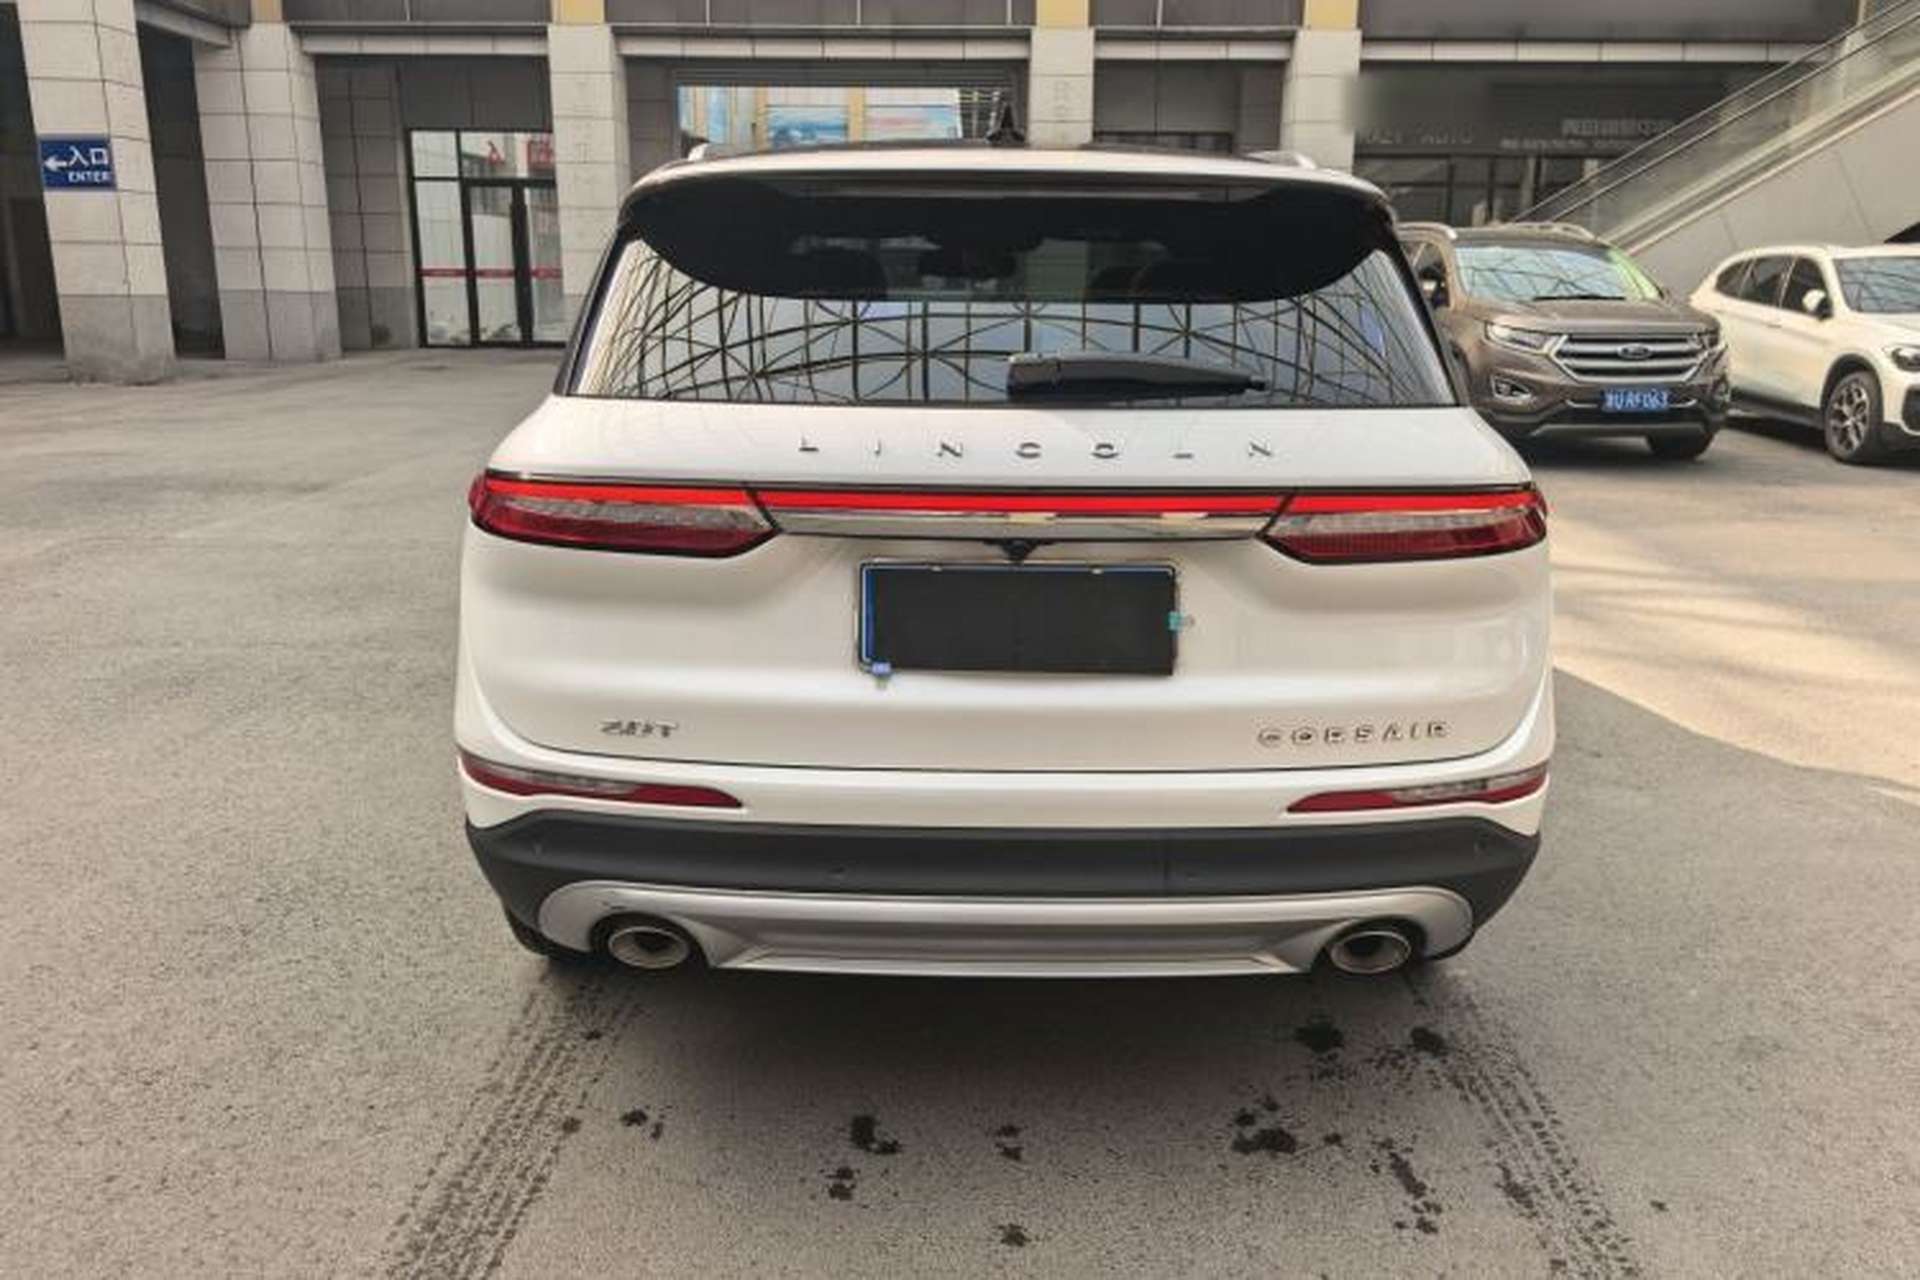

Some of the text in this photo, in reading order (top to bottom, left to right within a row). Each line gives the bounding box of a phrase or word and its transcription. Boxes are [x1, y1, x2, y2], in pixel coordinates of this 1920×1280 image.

[69, 146, 109, 167] 入口
[68, 171, 111, 183] ENTER
[1257, 721, 1450, 748] CORSAIR
